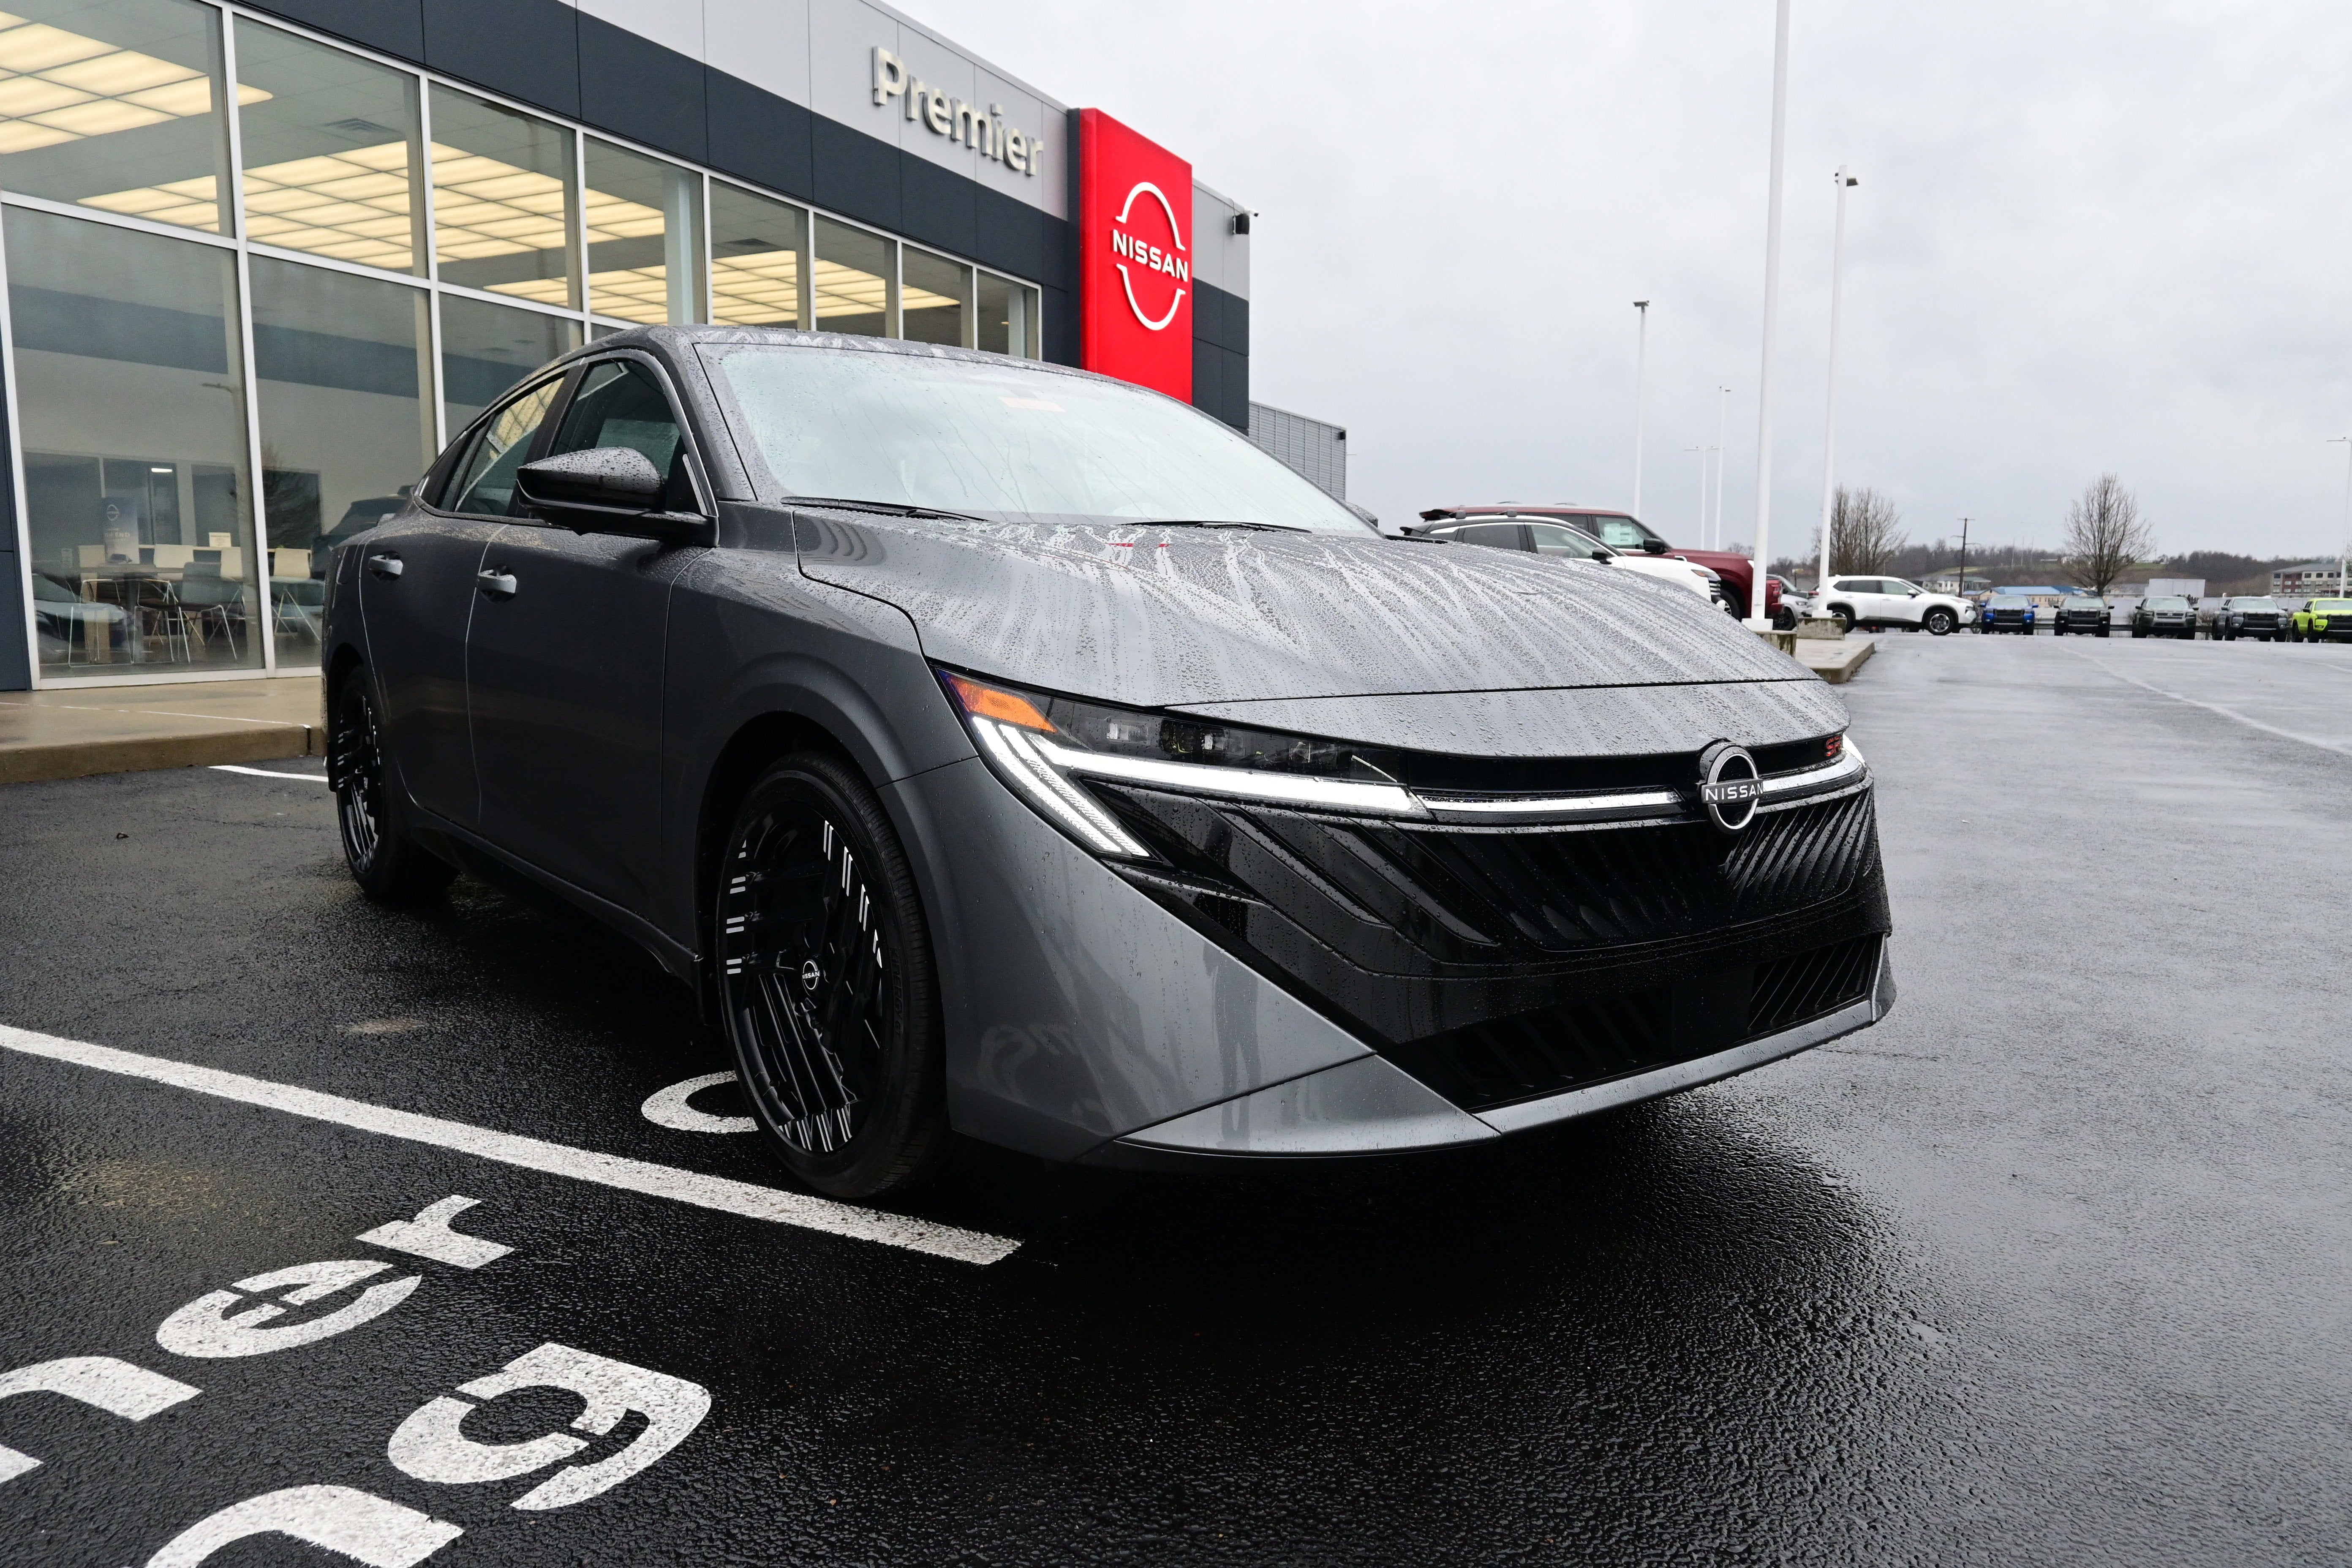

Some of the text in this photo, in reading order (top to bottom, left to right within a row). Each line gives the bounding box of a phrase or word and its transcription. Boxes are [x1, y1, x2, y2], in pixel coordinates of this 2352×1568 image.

[872, 46, 1043, 176] Premier
[1113, 229, 1188, 282] NISSAN
[1705, 783, 1763, 801] NISSAN
